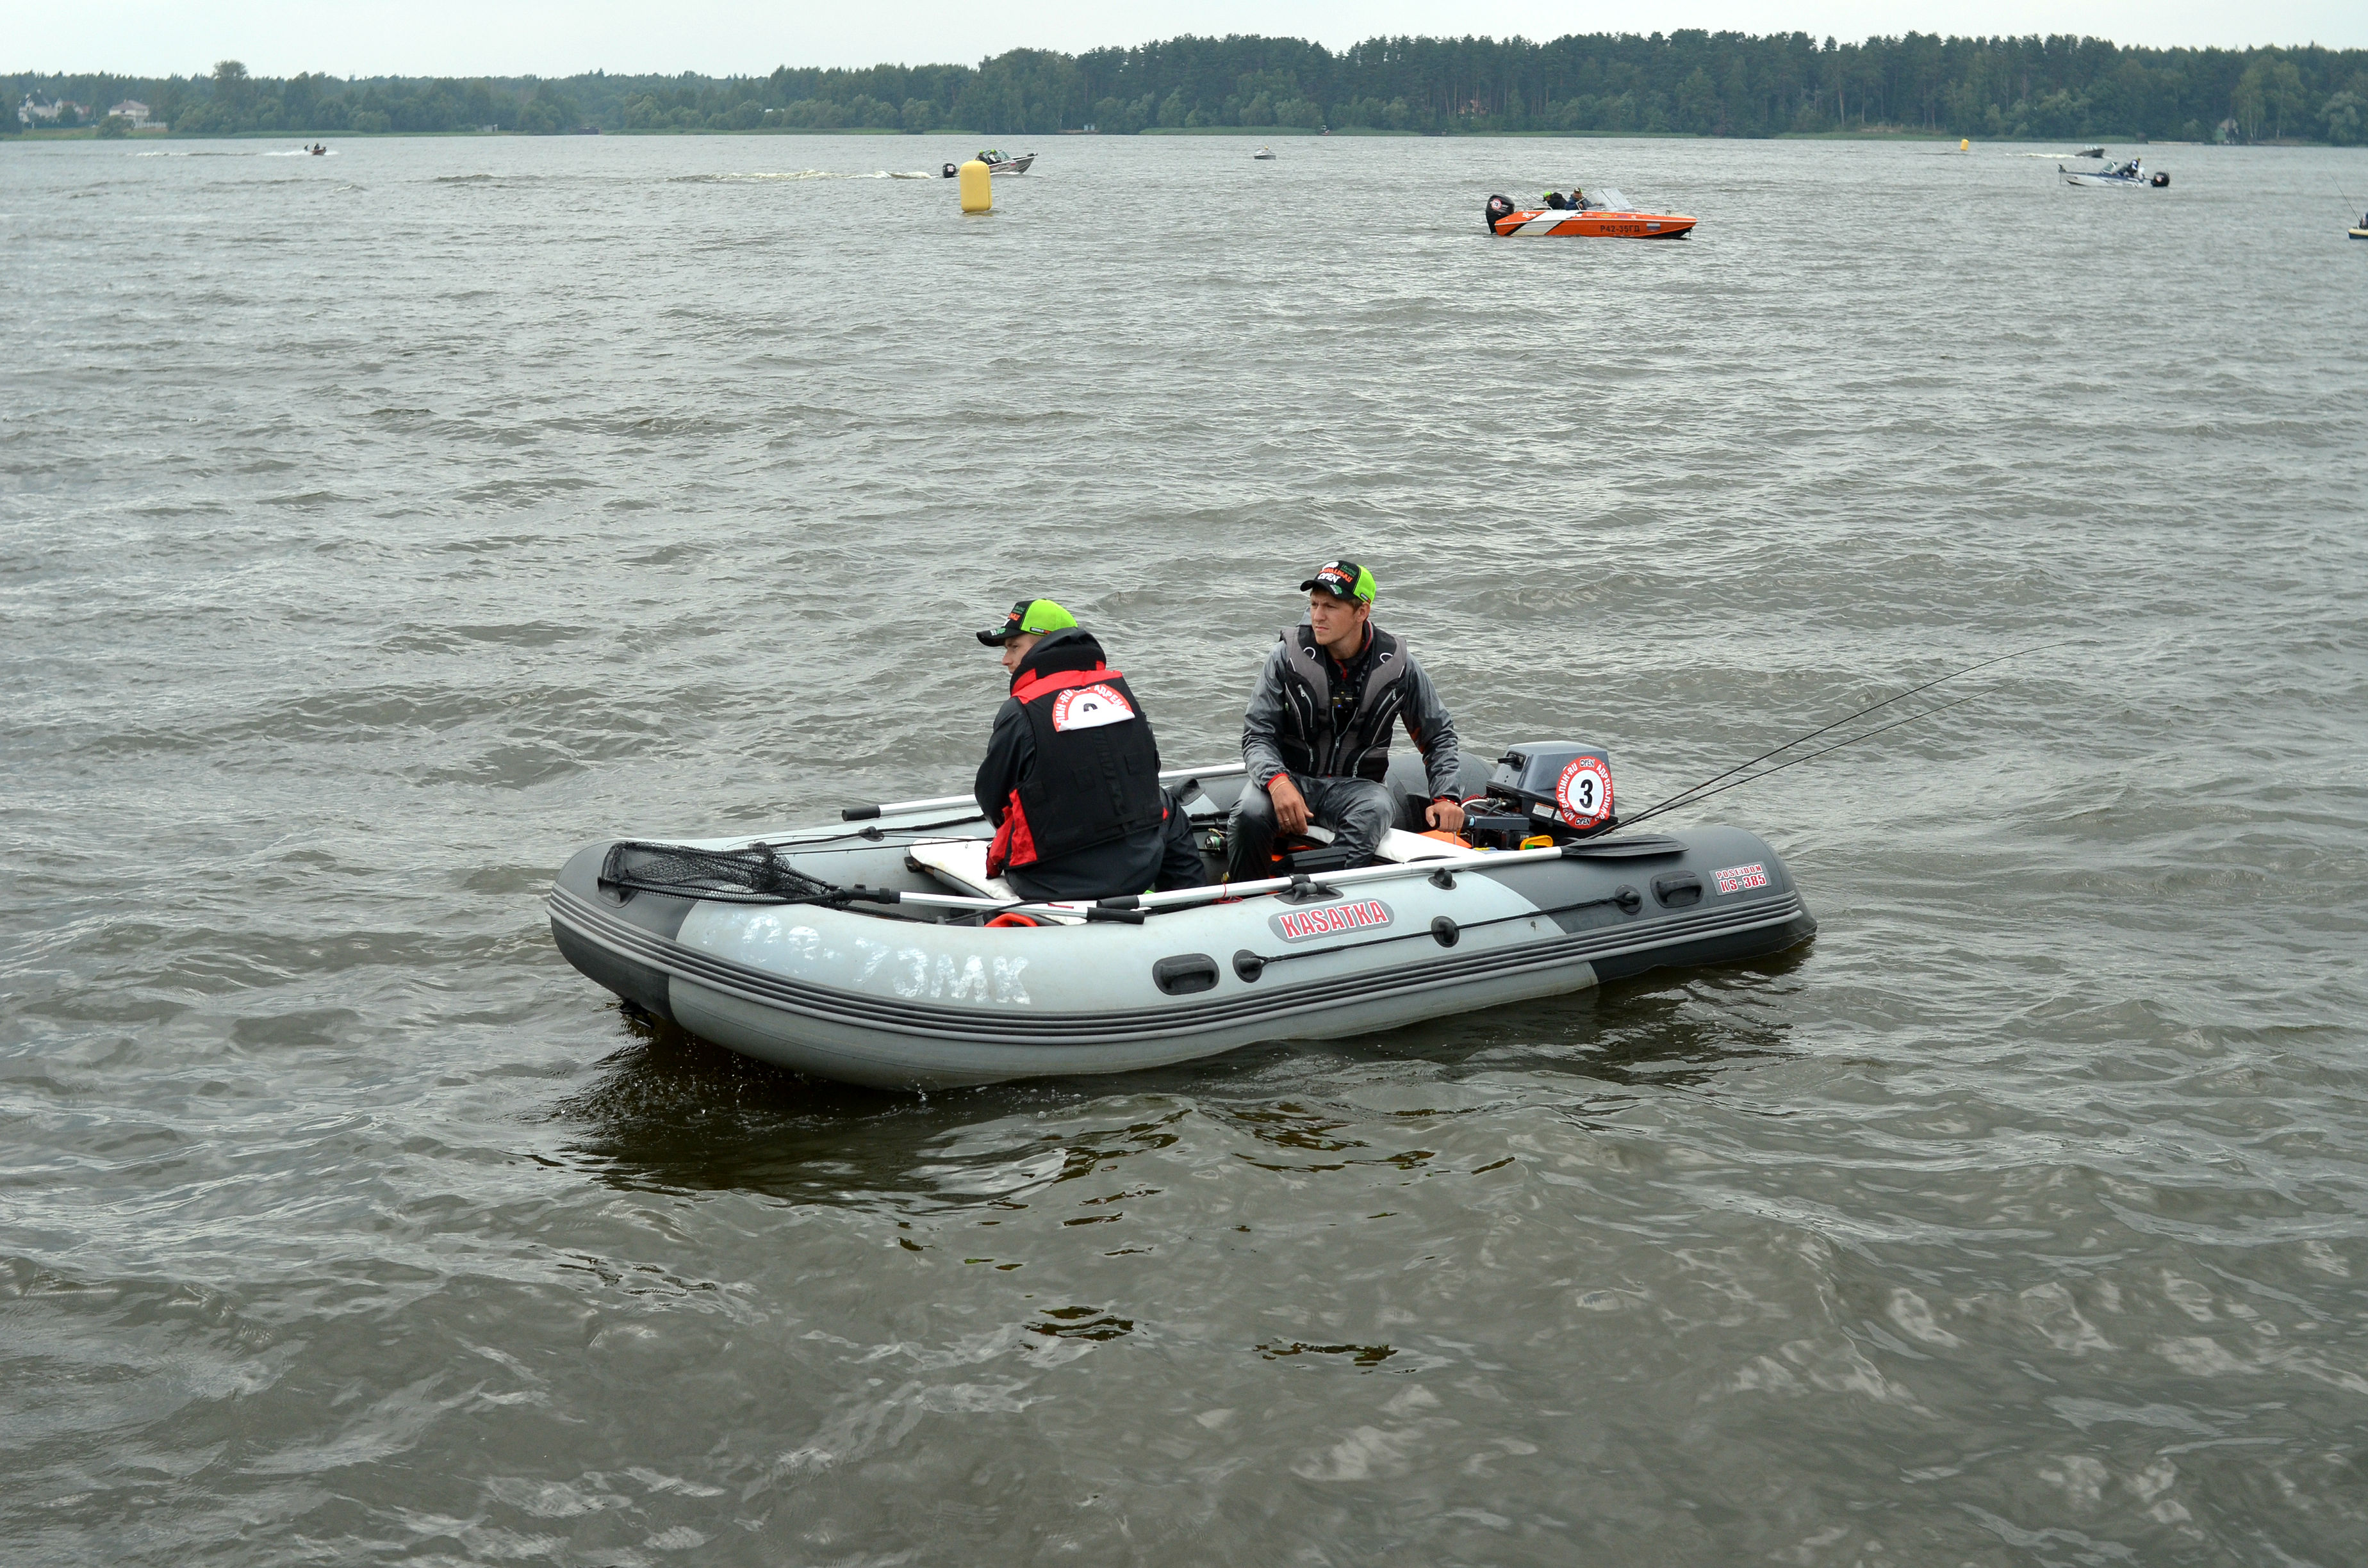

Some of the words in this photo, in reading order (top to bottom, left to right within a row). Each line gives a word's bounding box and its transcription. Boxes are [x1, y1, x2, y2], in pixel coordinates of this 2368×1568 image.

[1317, 573, 1341, 584] OPEN
[1580, 759, 1595, 767] OPEN
[1579, 779, 1593, 808] 3
[1575, 817, 1592, 826] OPEN
[1720, 873, 1766, 893] KS-385
[1279, 901, 1388, 938] KASATKA
